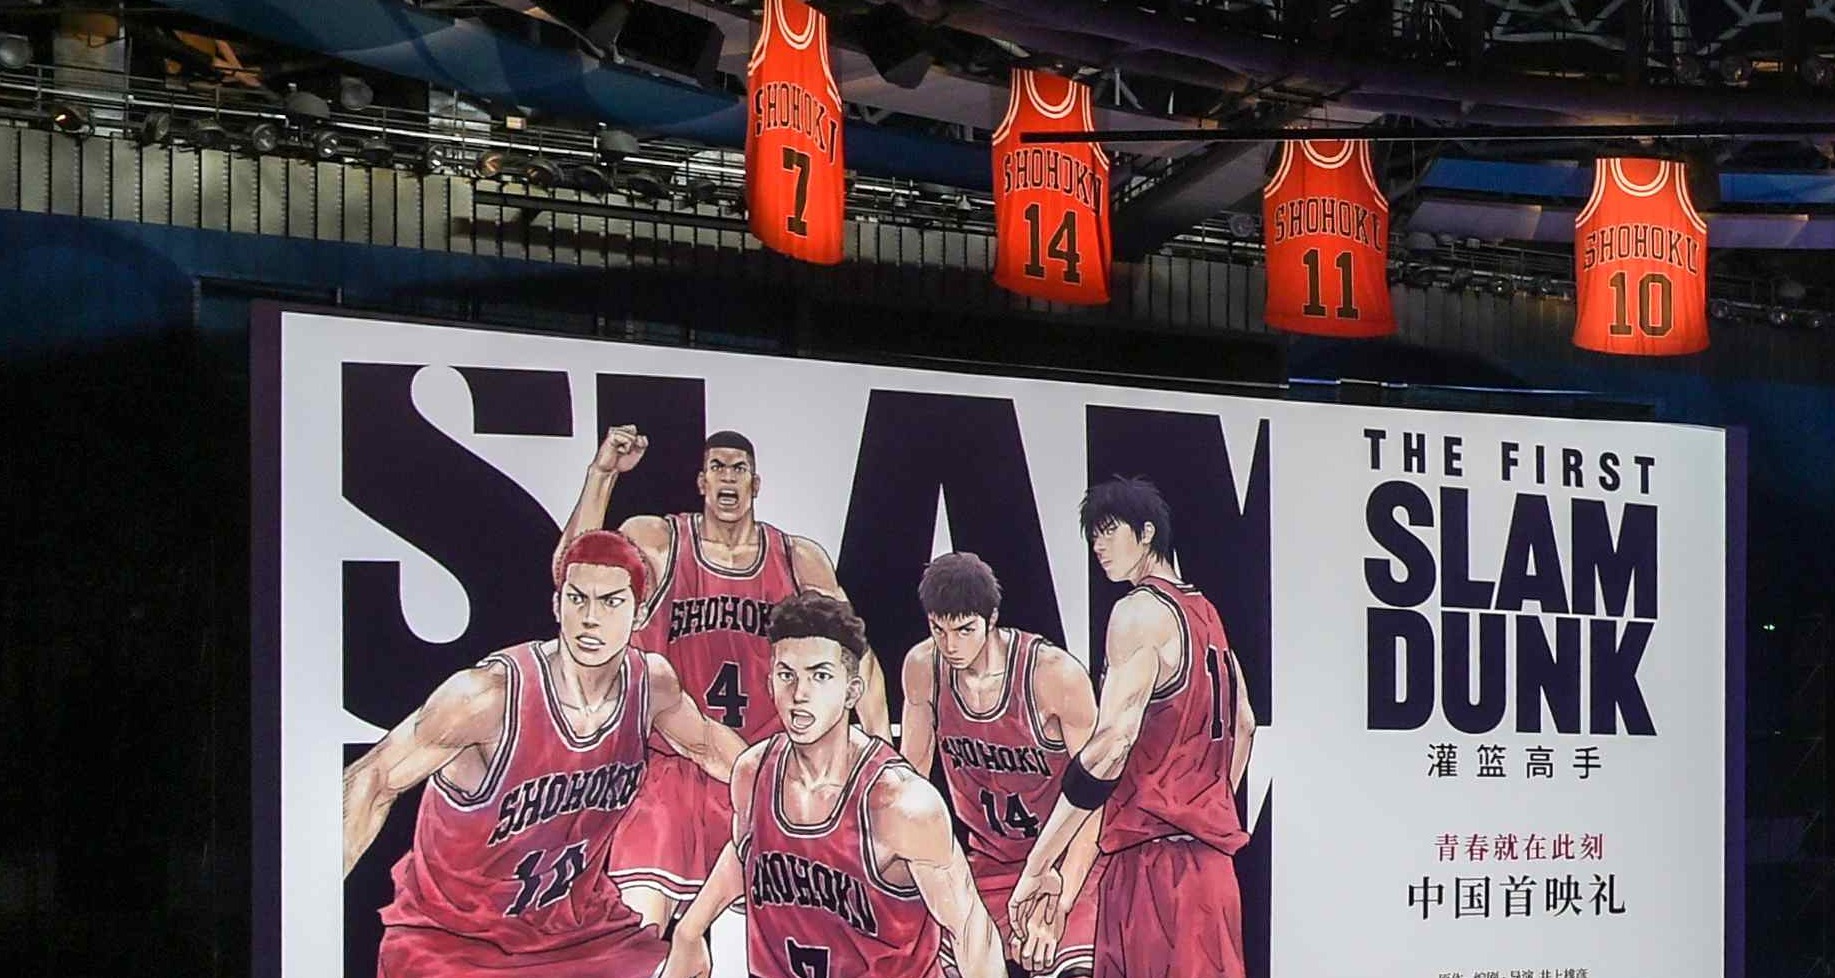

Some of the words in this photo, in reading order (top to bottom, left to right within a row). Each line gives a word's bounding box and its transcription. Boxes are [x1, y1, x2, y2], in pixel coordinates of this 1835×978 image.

[781, 145, 812, 238] 7
[1023, 201, 1082, 286] 14
[1584, 224, 1699, 275] SHOHOKU
[1302, 247, 1360, 320] 11
[1609, 270, 1674, 338] 10
[1364, 428, 1463, 477] THE
[1501, 441, 1655, 494] FIRST
[1364, 480, 1658, 619] SLAM
[703, 661, 748, 729] 4
[1366, 607, 1658, 736] DUNK
[1427, 743, 1602, 780] 灌篮高手
[978, 789, 1040, 839] 14
[1434, 833, 1605, 862] 青春就在此刻
[1407, 872, 1627, 920] 中国首映礼
